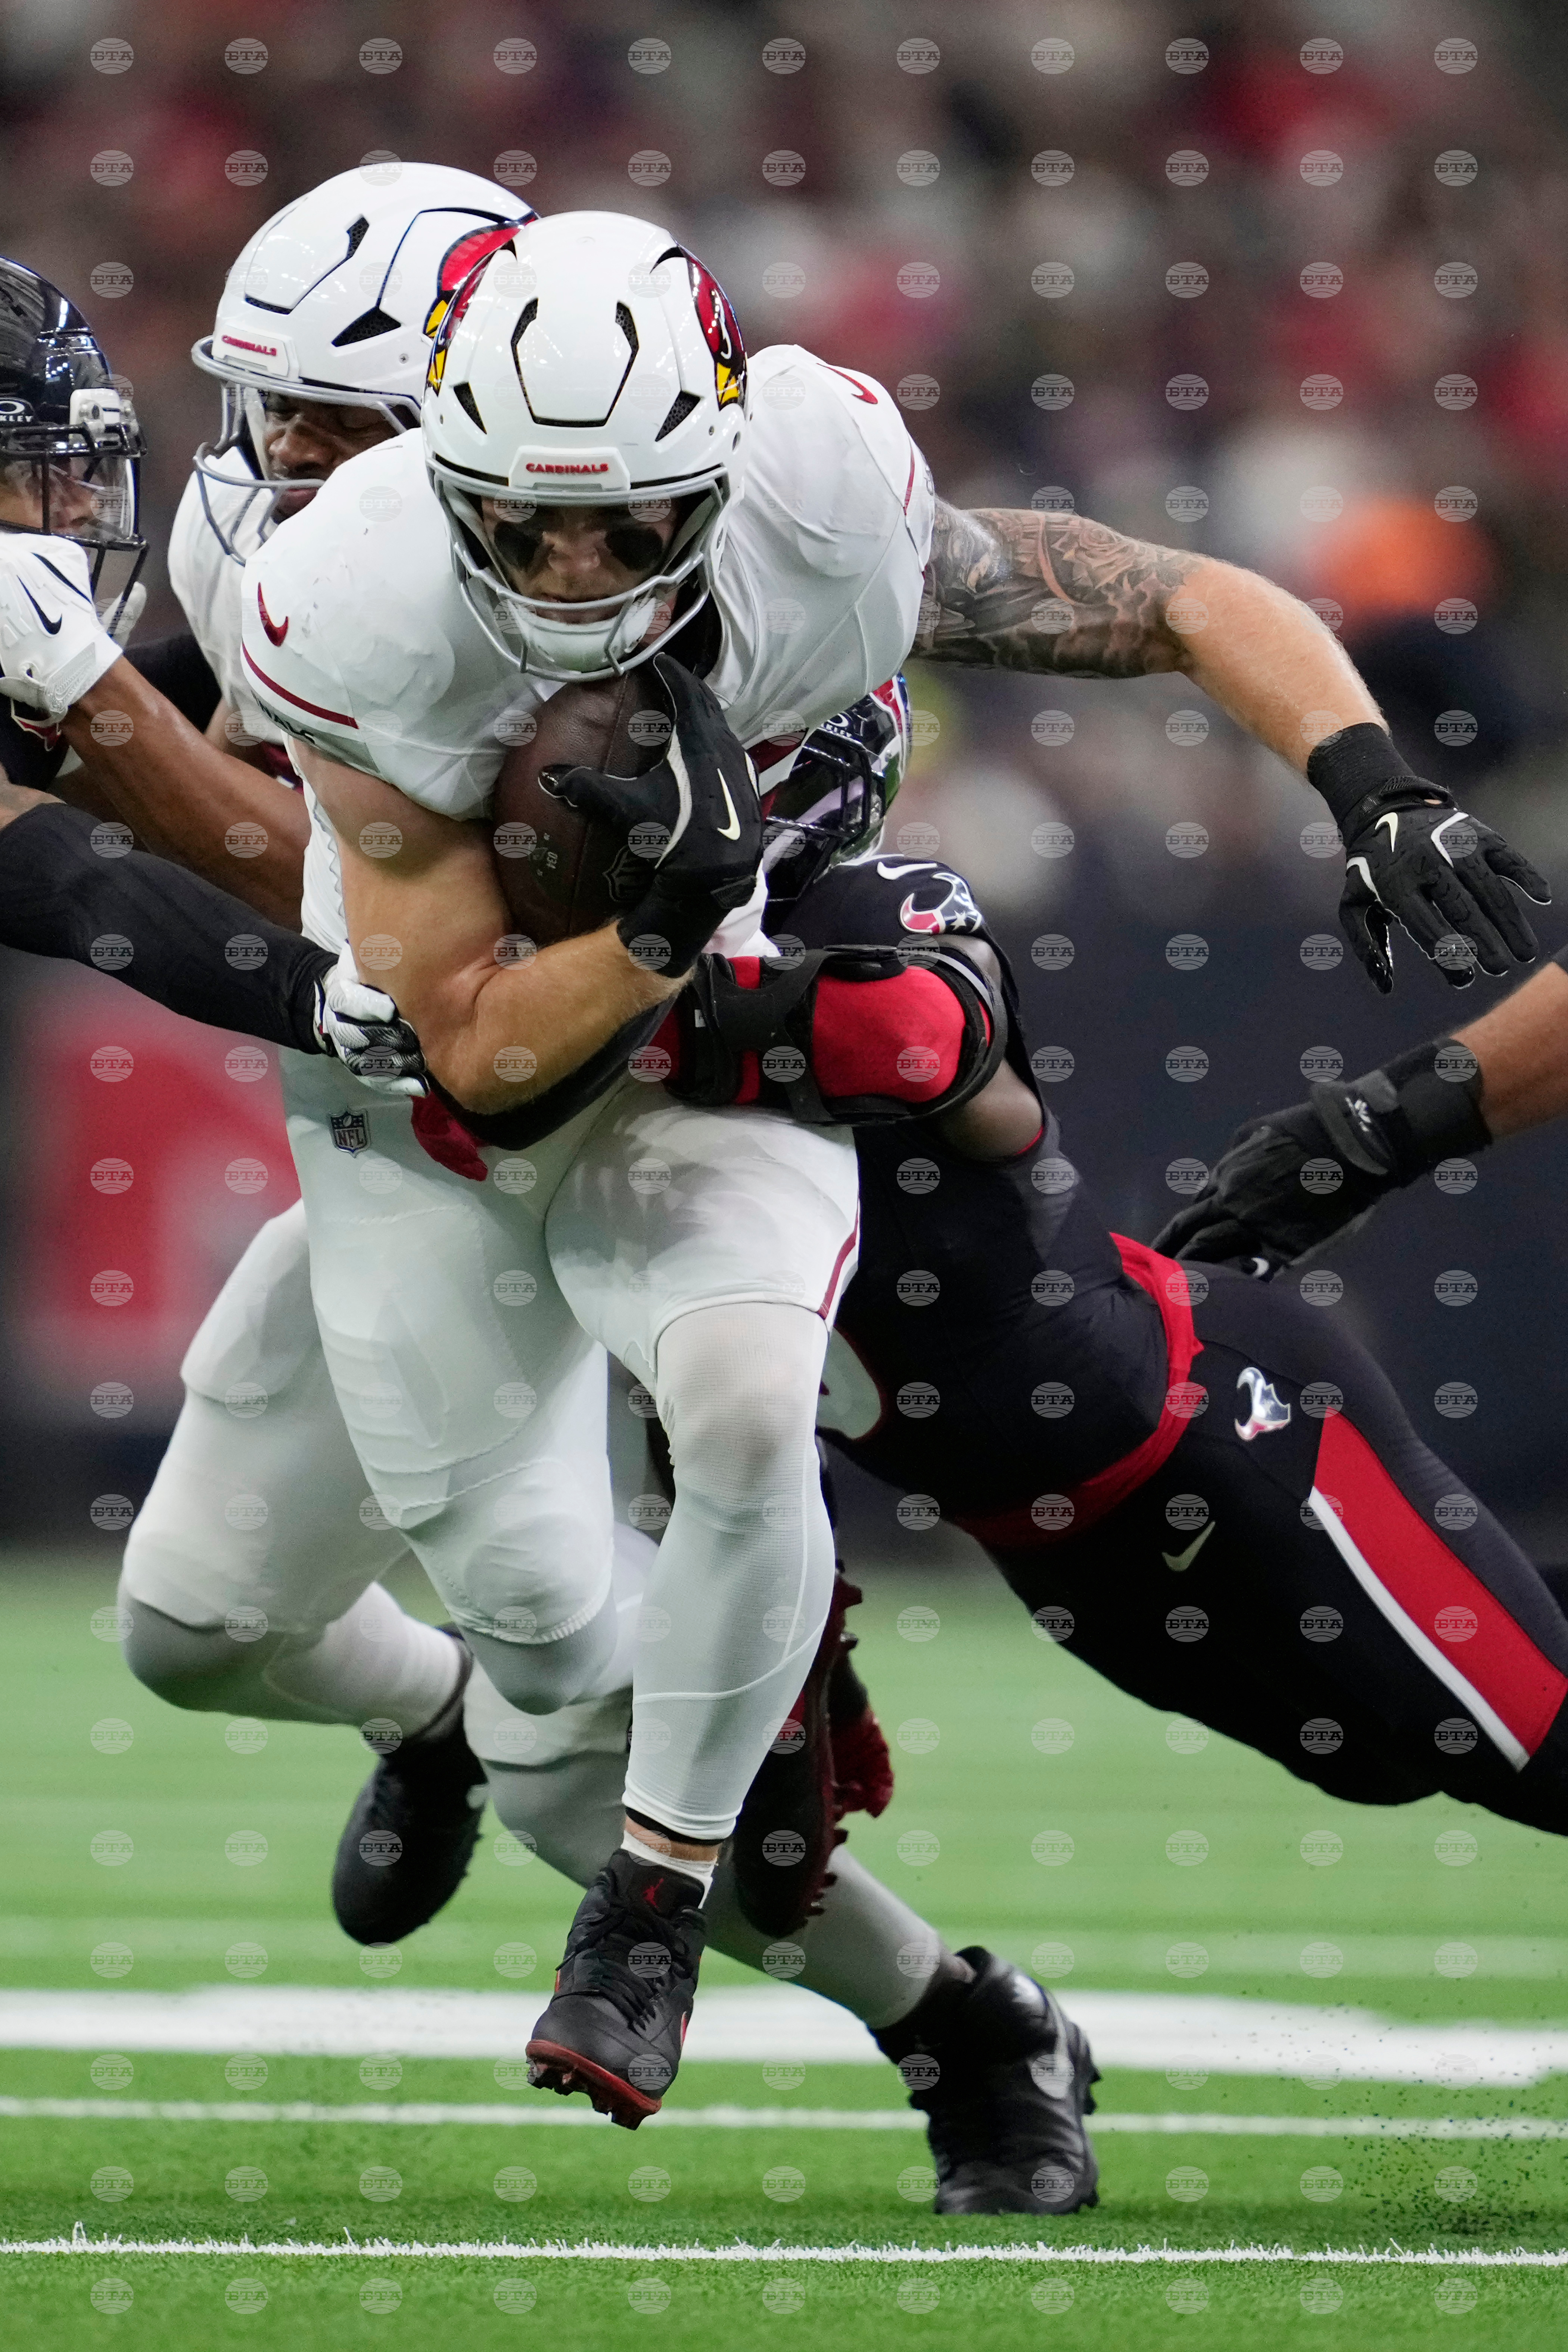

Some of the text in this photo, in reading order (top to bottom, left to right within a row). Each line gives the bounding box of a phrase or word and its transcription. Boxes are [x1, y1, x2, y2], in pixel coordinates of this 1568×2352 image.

[526, 463, 609, 473] CARDINALS
[821, 723, 852, 738] KLEY
[336, 1128, 365, 1148] NFL
